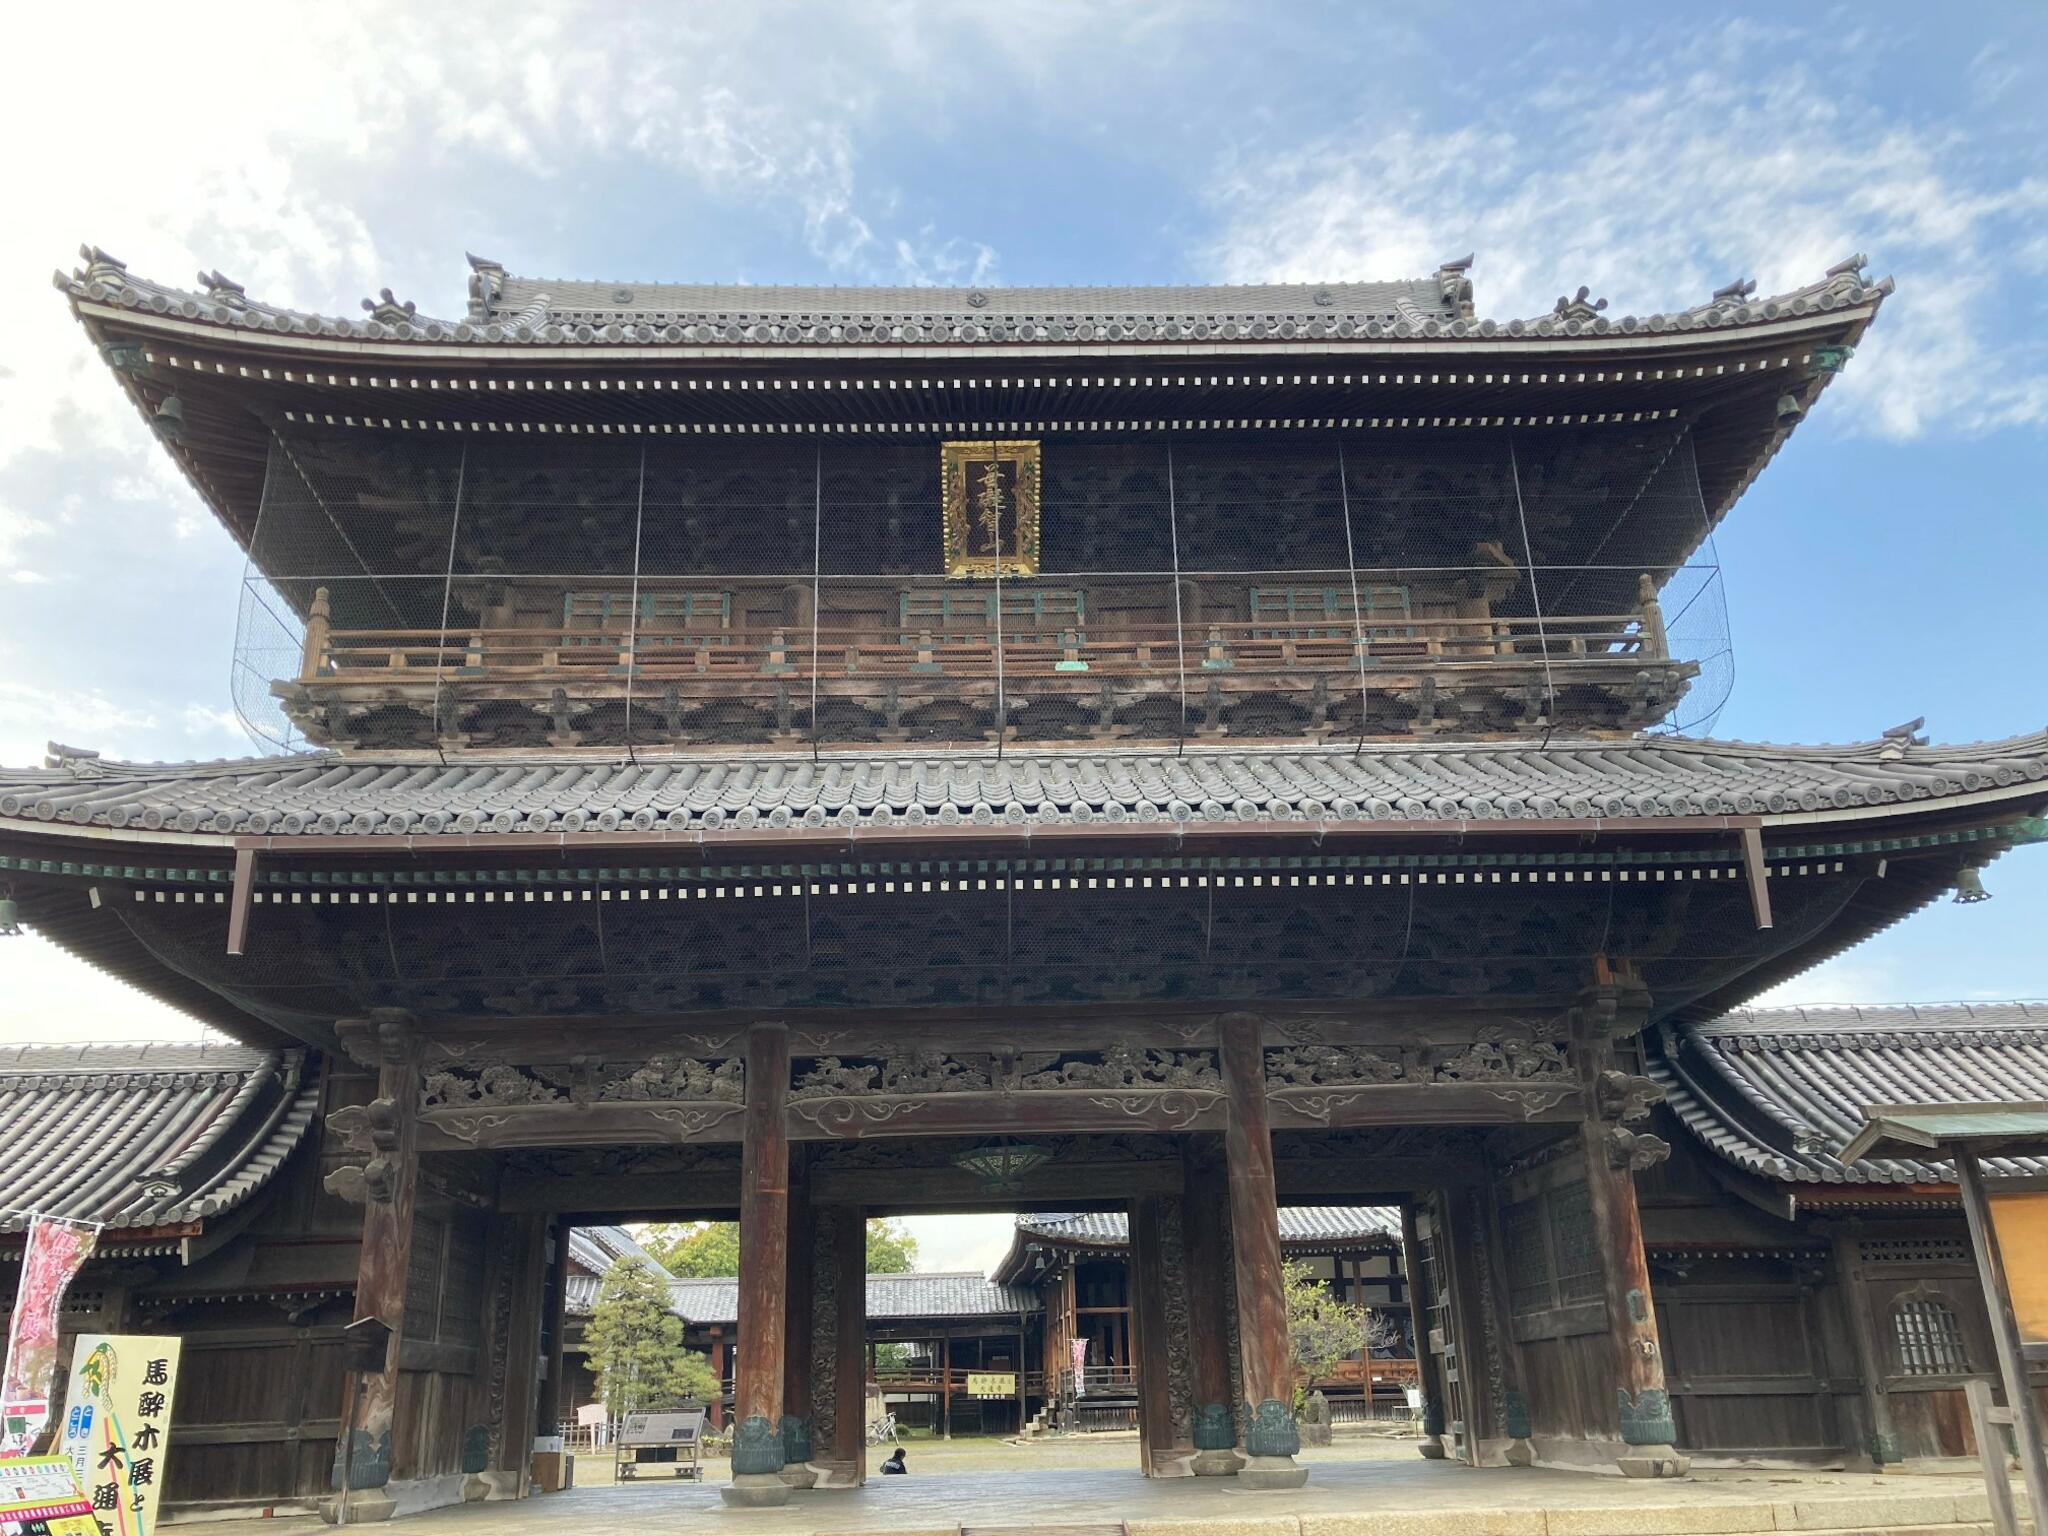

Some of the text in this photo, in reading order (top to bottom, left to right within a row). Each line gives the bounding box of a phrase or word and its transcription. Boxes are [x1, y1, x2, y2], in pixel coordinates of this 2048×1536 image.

[128, 1358, 169, 1513] 馬酔木展と
